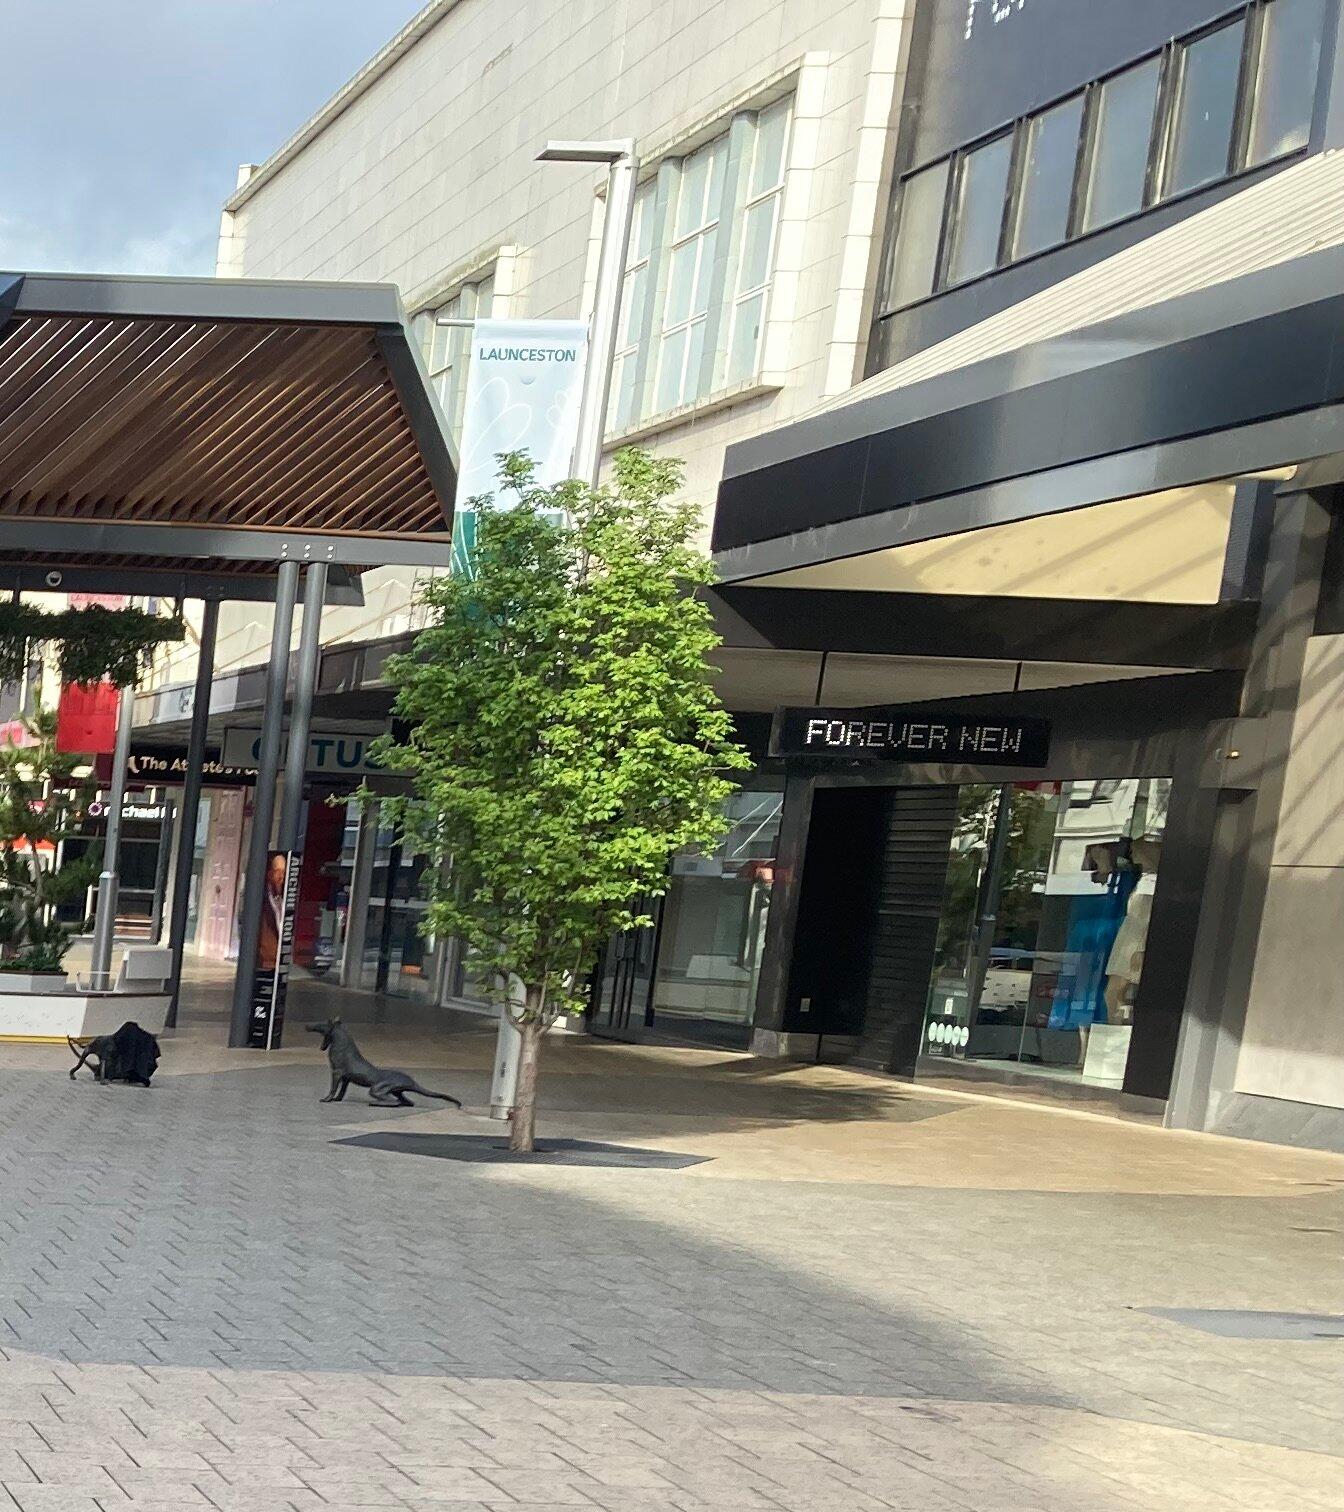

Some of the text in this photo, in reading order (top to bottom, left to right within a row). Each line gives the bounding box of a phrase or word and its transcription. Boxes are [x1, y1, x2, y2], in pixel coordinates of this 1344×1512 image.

[479, 347, 577, 363] LAUNCESTON
[806, 719, 1023, 753] FOREVER NEW
[140, 756, 168, 771] The
